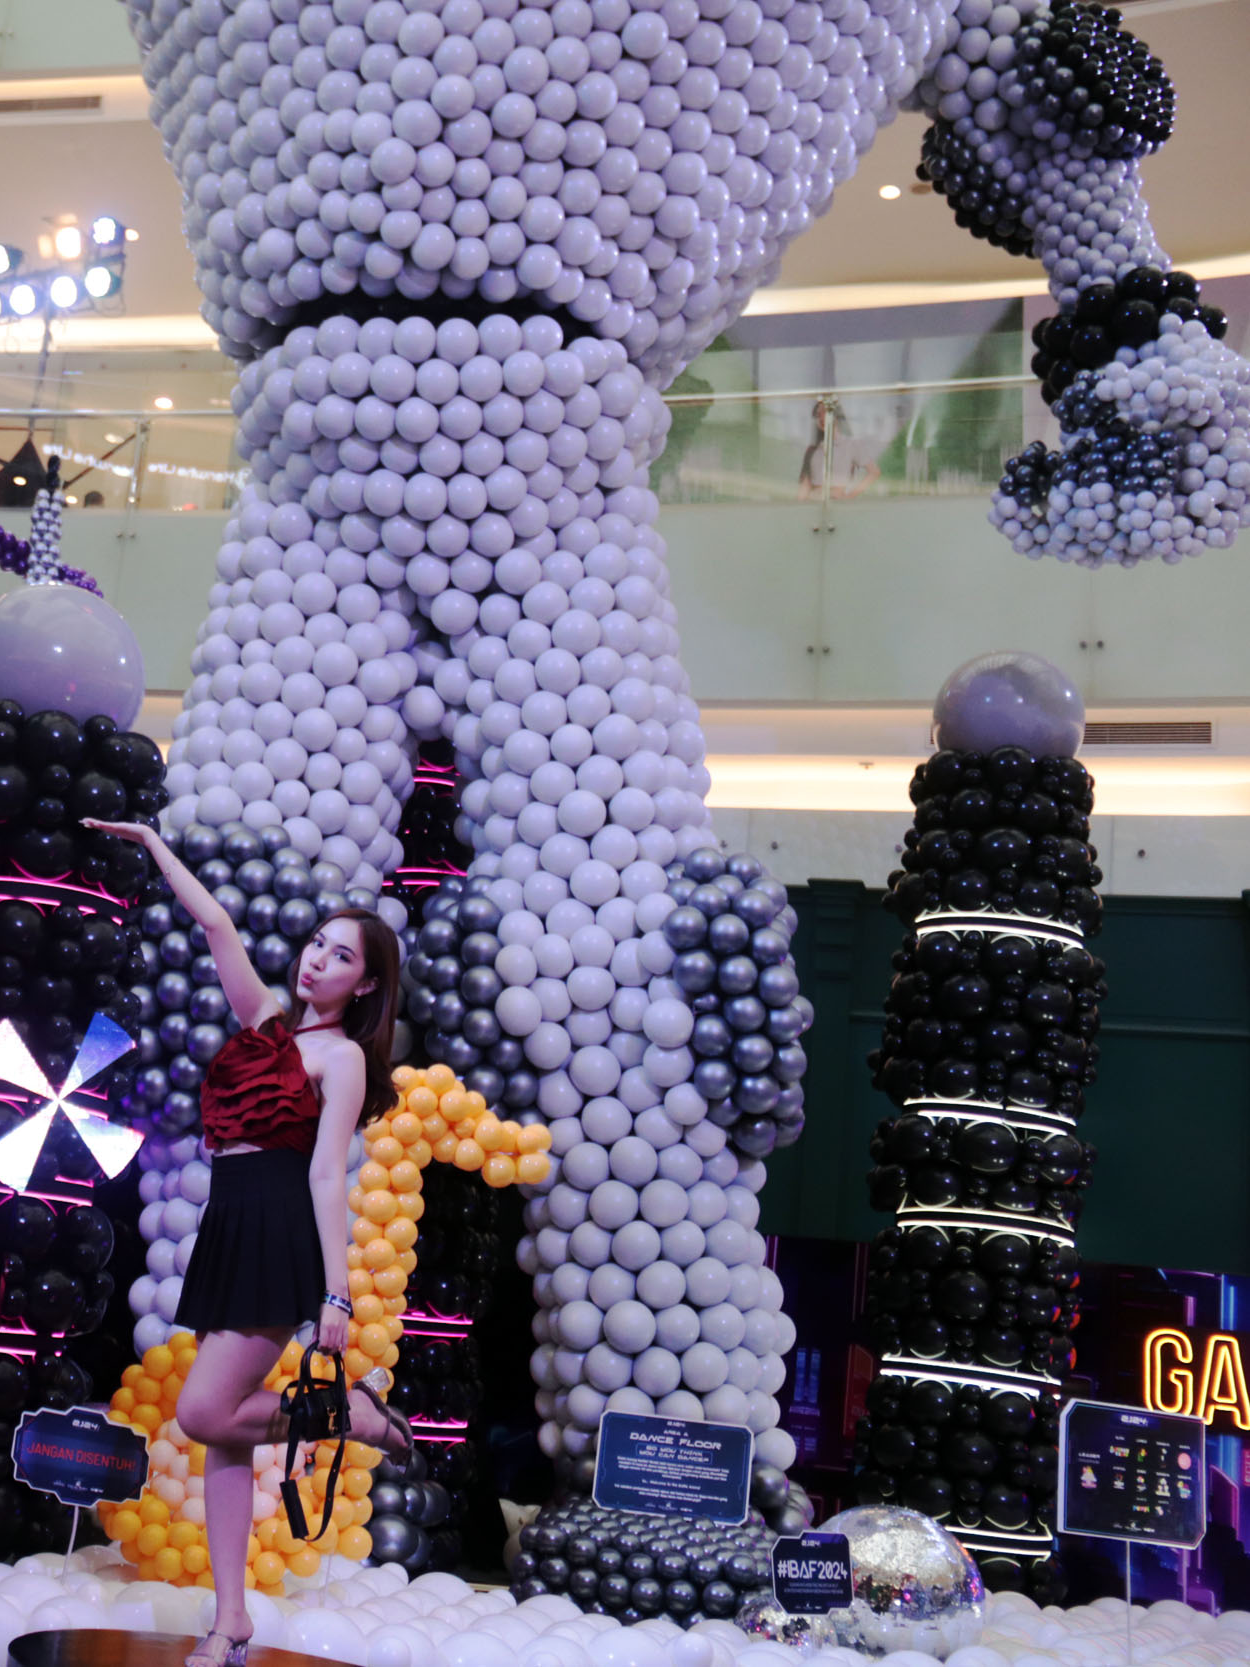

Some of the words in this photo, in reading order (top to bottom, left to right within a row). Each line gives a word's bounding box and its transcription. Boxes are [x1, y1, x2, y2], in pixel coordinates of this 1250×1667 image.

[630, 1432, 674, 1445] DANCE
[678, 1438, 722, 1451] FLOOR
[27, 1442, 74, 1460] JANGAN
[76, 1449, 136, 1471] DISENTUH!
